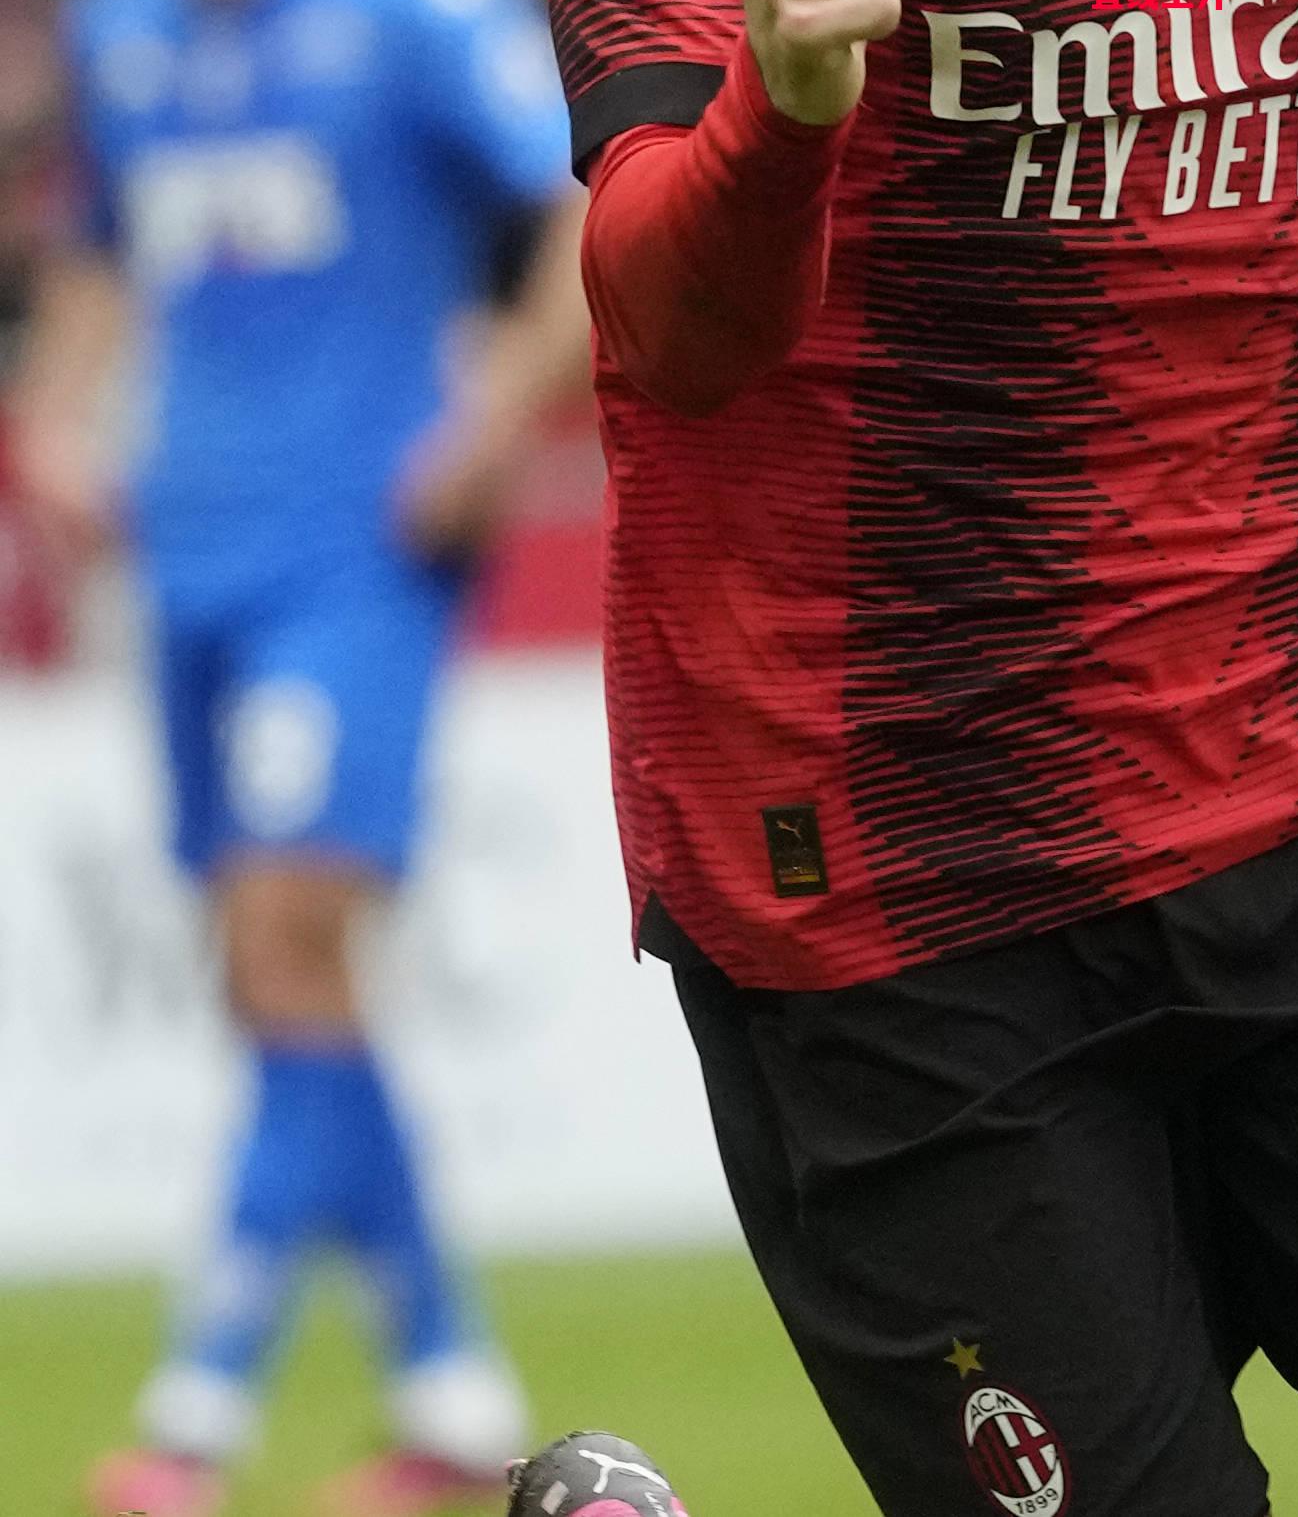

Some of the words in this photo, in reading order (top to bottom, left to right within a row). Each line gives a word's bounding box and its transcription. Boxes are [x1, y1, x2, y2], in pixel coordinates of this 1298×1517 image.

[1001, 114, 1143, 220] FLY
[969, 1392, 1019, 1429] ACM
[1014, 1487, 1059, 1515] 1899
